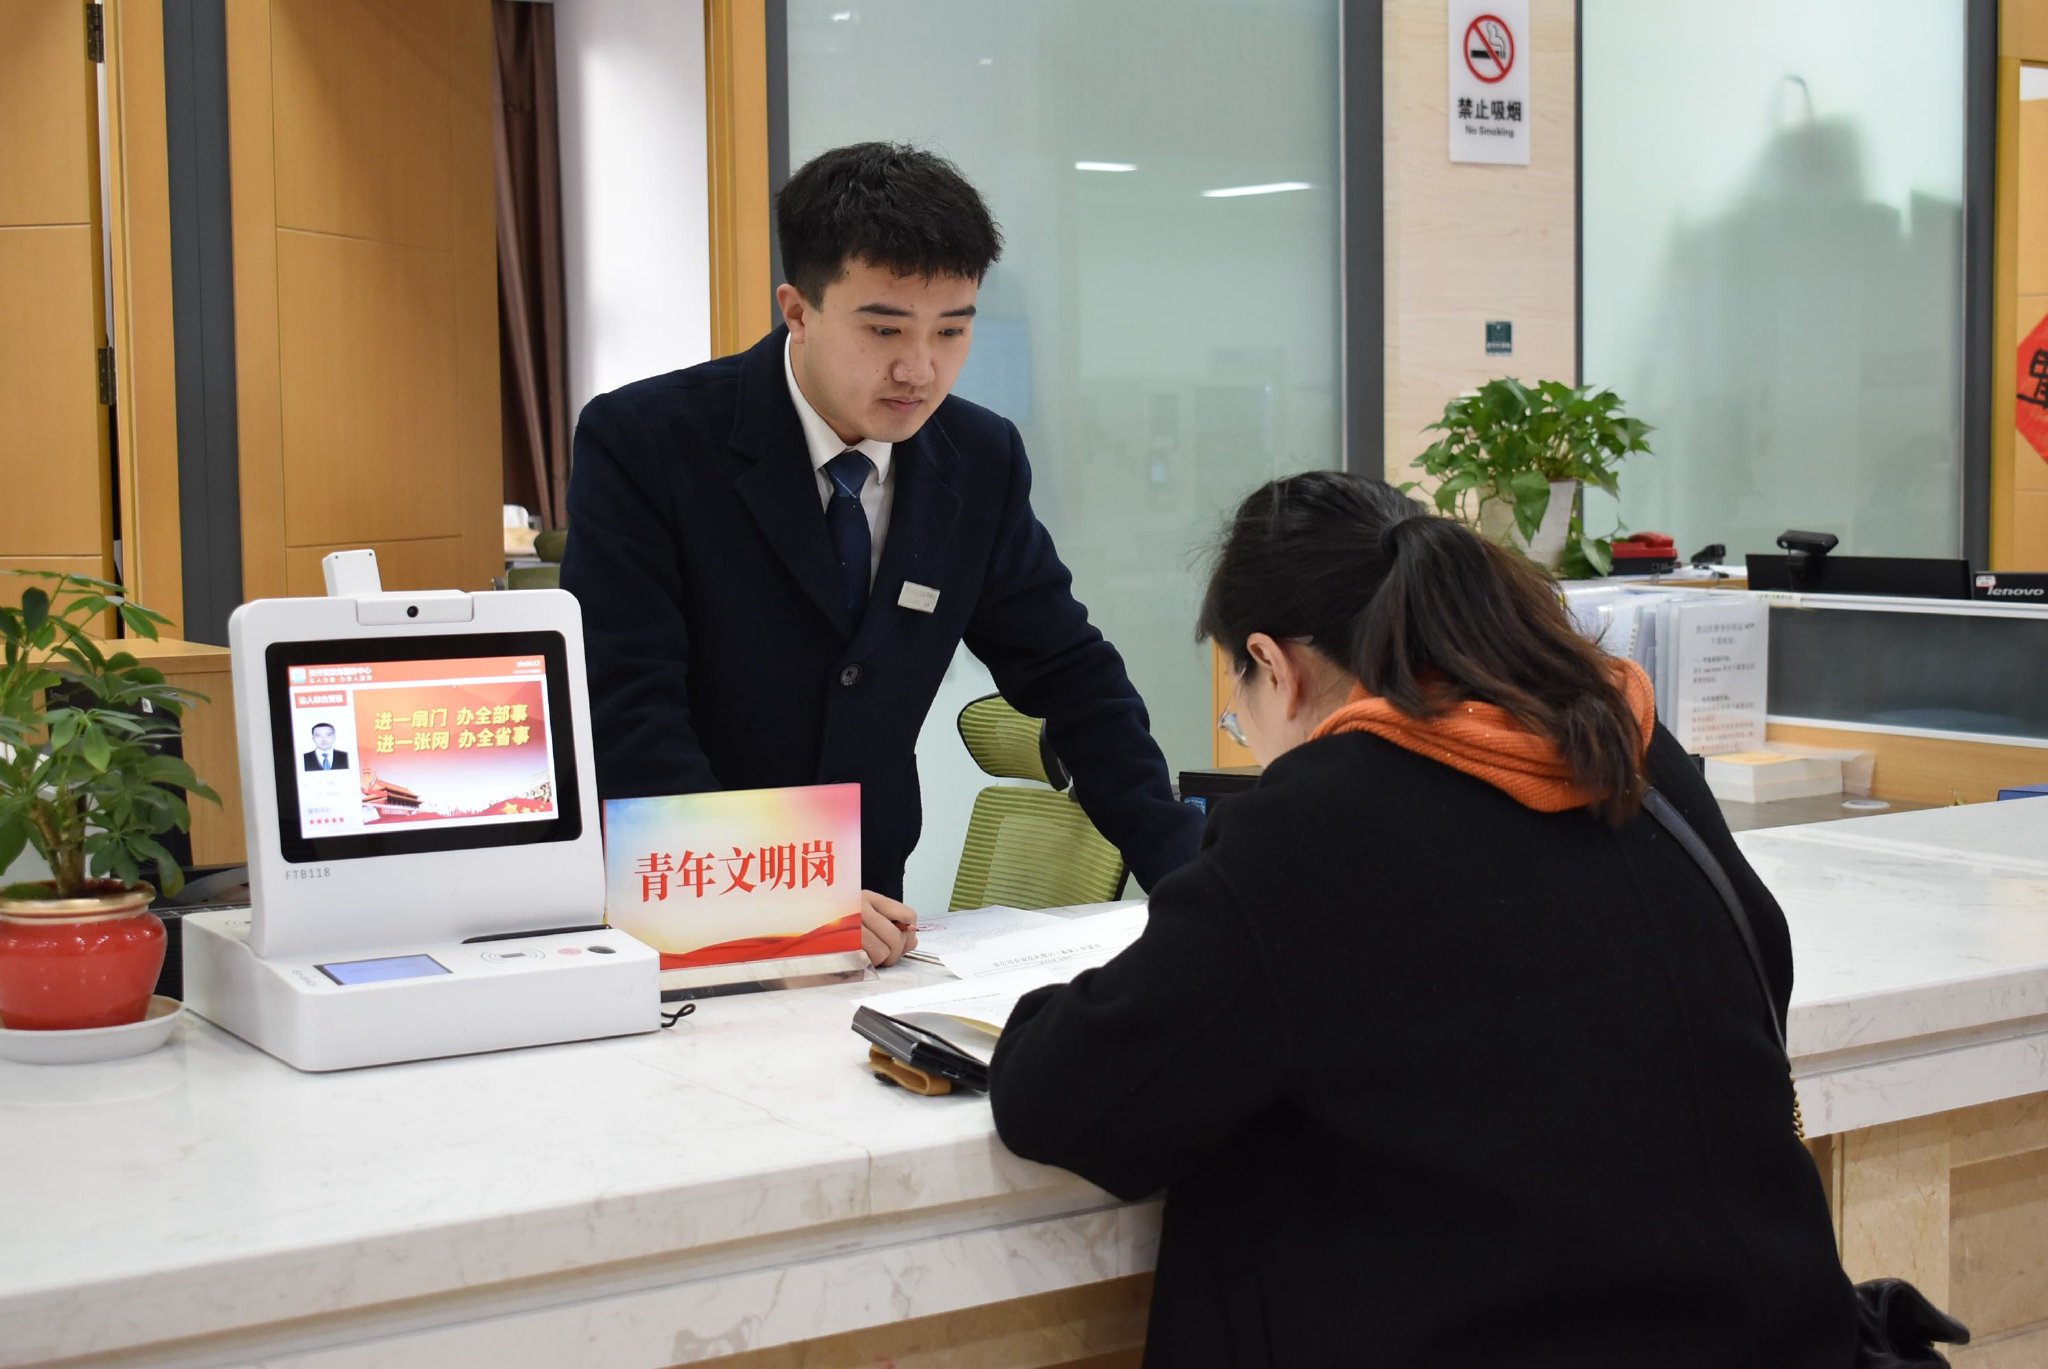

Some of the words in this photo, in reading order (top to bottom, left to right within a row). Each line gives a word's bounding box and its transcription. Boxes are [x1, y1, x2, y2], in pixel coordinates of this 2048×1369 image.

[1458, 97, 1522, 122] 禁止吸烟
[1465, 125, 1477, 135] No
[1479, 126, 1514, 138] Smoking
[1987, 585, 2045, 596] lenovo
[374, 708, 448, 731] 进一扇门
[456, 704, 529, 726] 办全部事
[376, 731, 450, 753] 进一张网
[458, 726, 530, 748] 办全省事
[285, 867, 330, 880] FTB118
[634, 840, 835, 902] 青年文明岗
